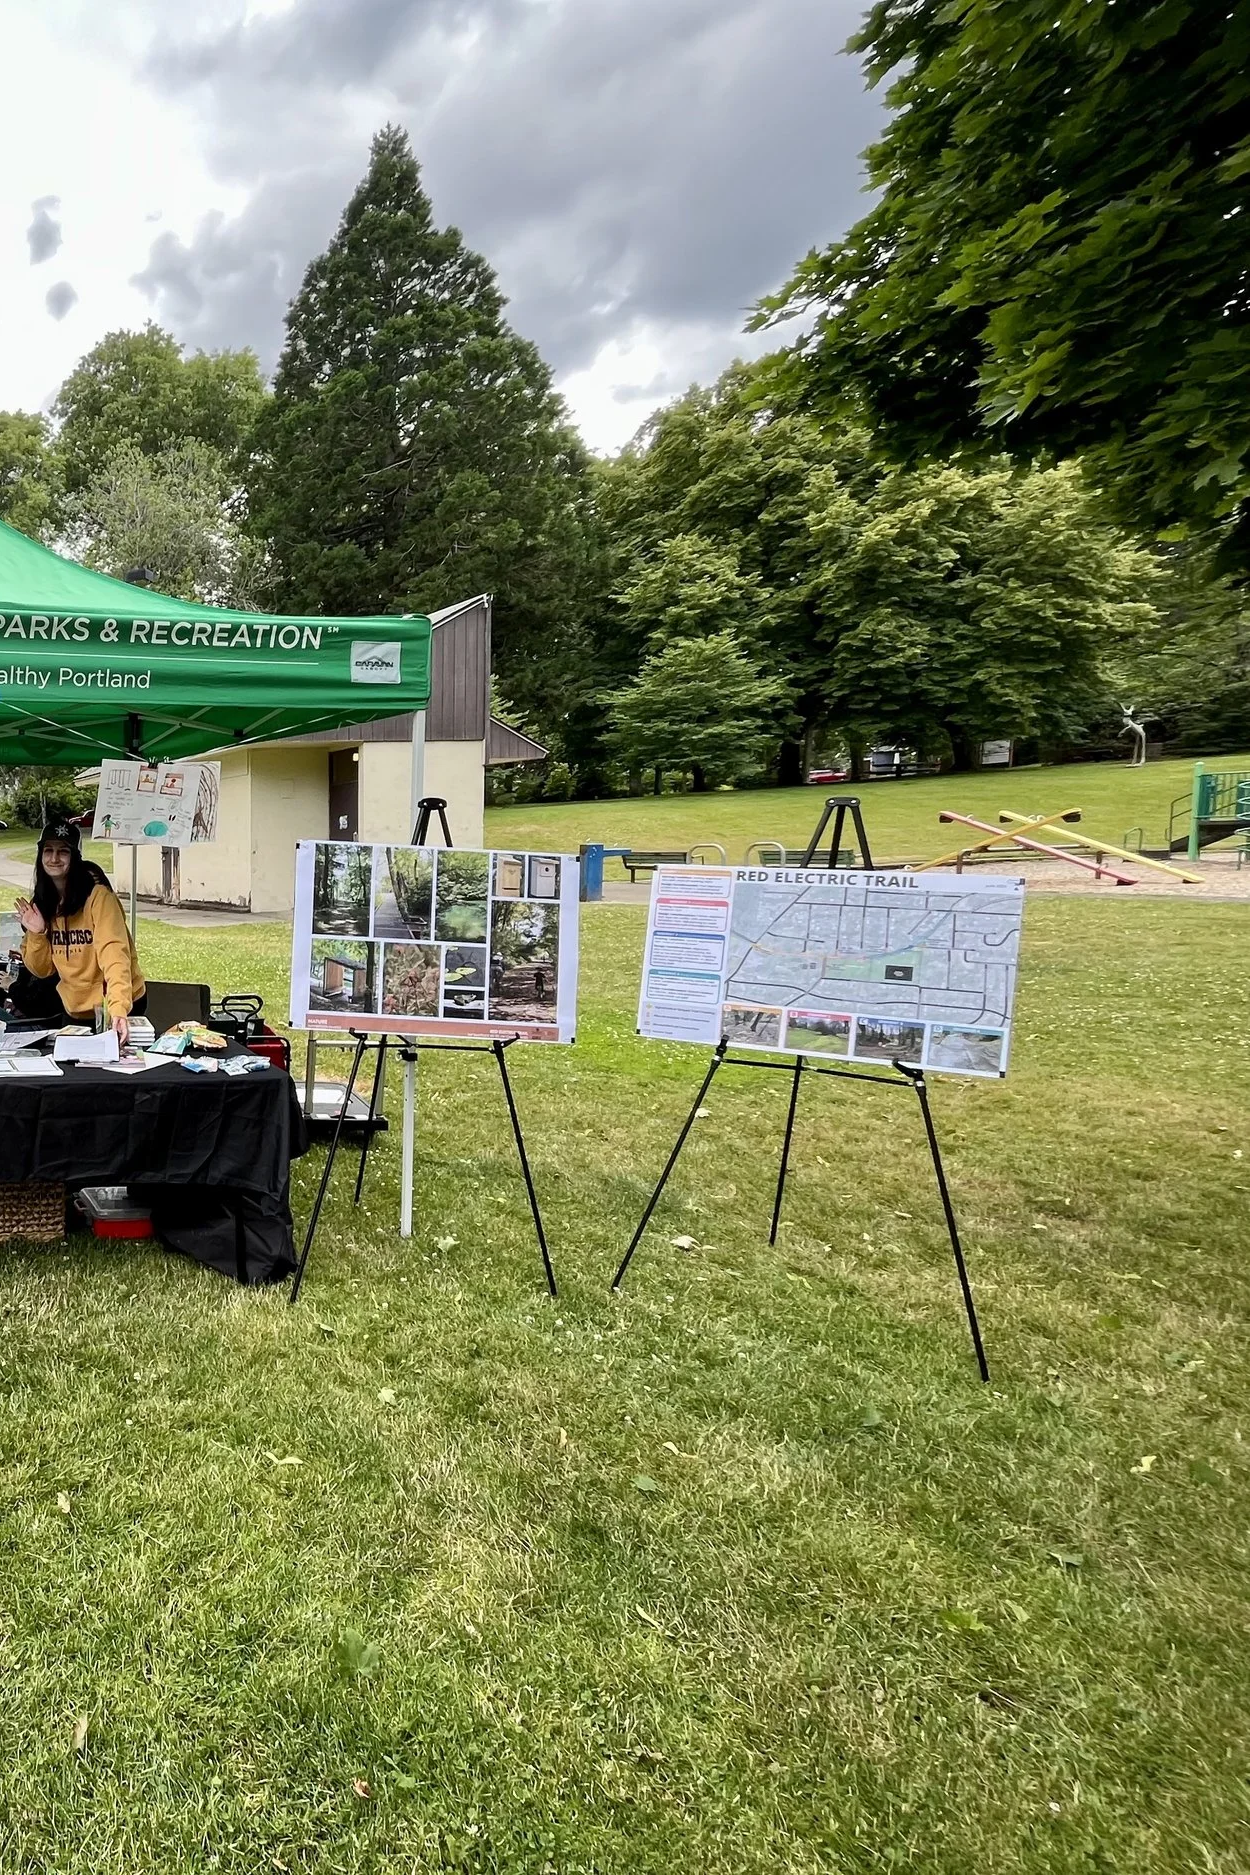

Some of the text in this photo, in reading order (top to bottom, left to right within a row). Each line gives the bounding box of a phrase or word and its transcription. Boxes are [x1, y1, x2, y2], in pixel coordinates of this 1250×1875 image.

[99, 618, 120, 642] &
[129, 620, 323, 650] RECREATION
[58, 667, 151, 689] Portland
[736, 870, 919, 888] RED ELECTRIC TRAIL
